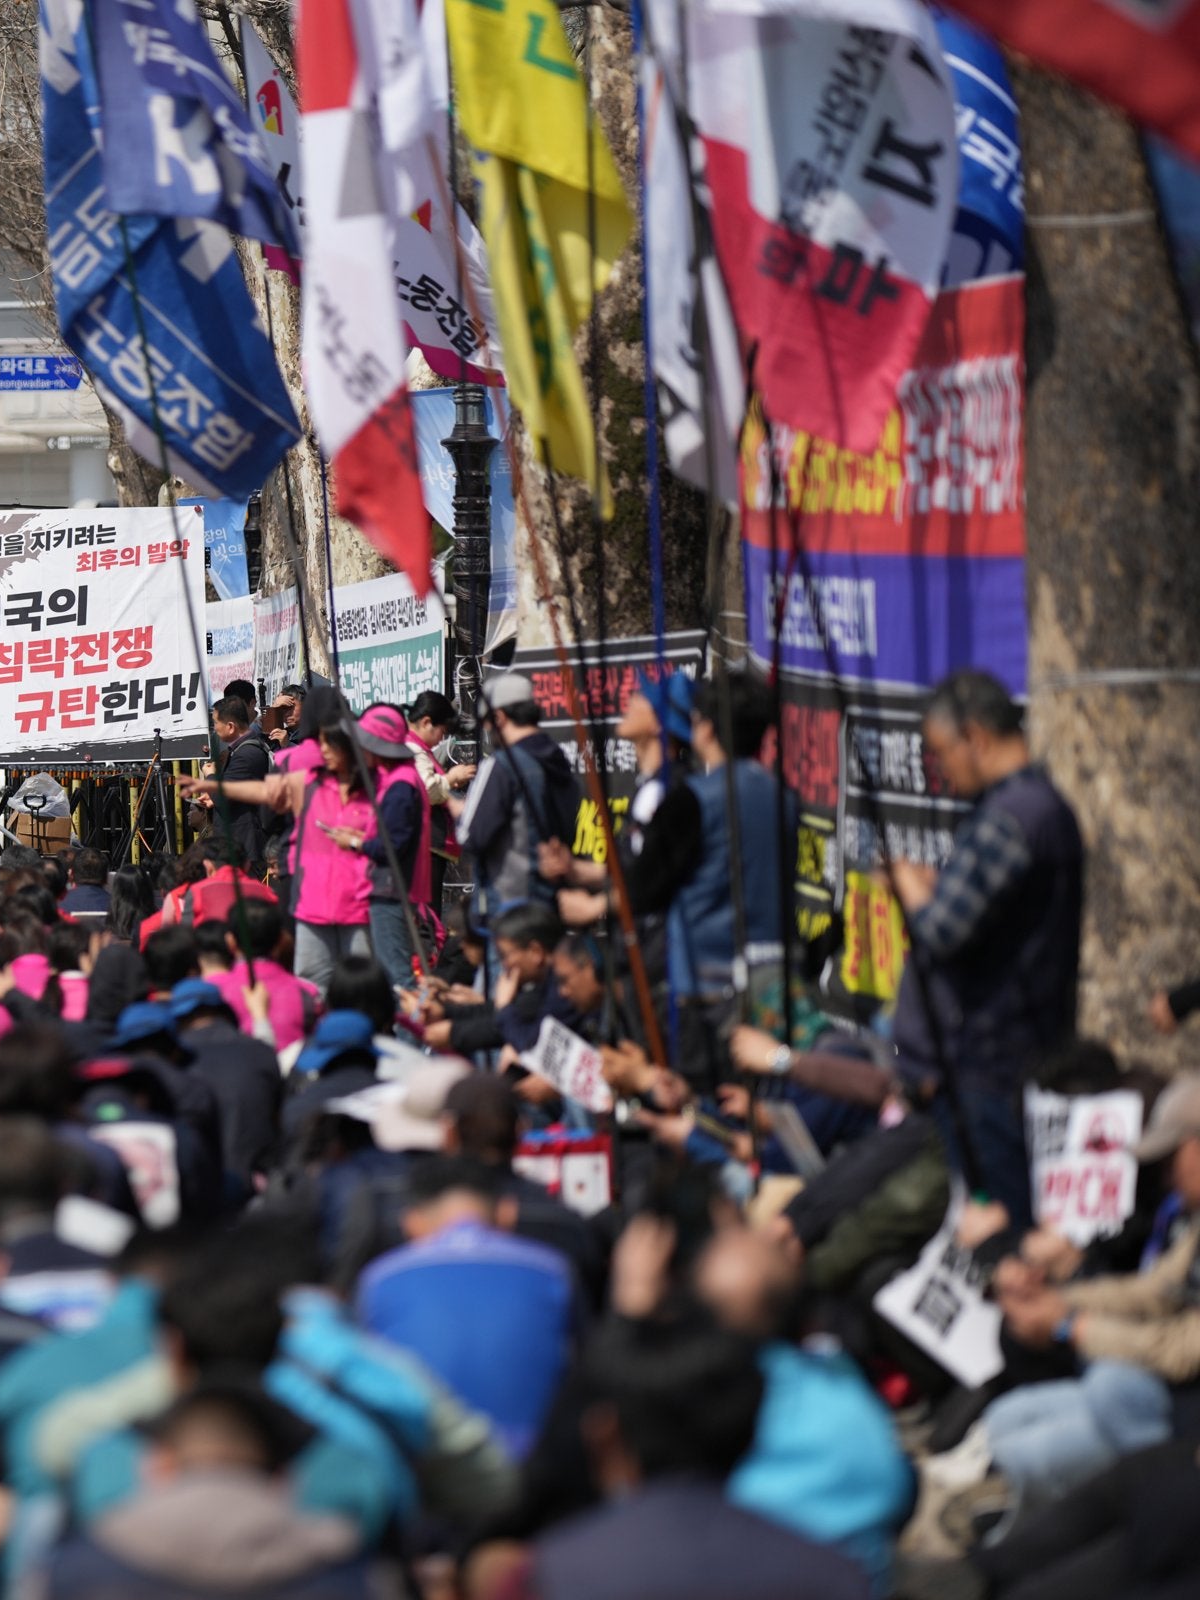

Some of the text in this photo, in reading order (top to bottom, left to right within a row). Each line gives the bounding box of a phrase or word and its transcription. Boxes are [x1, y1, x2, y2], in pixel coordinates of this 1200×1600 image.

[74, 296, 255, 472] 노동조합
[31, 524, 117, 552] 지키려는
[76, 539, 191, 573] 최후의 발악
[14, 671, 201, 734] 규탄한다!
